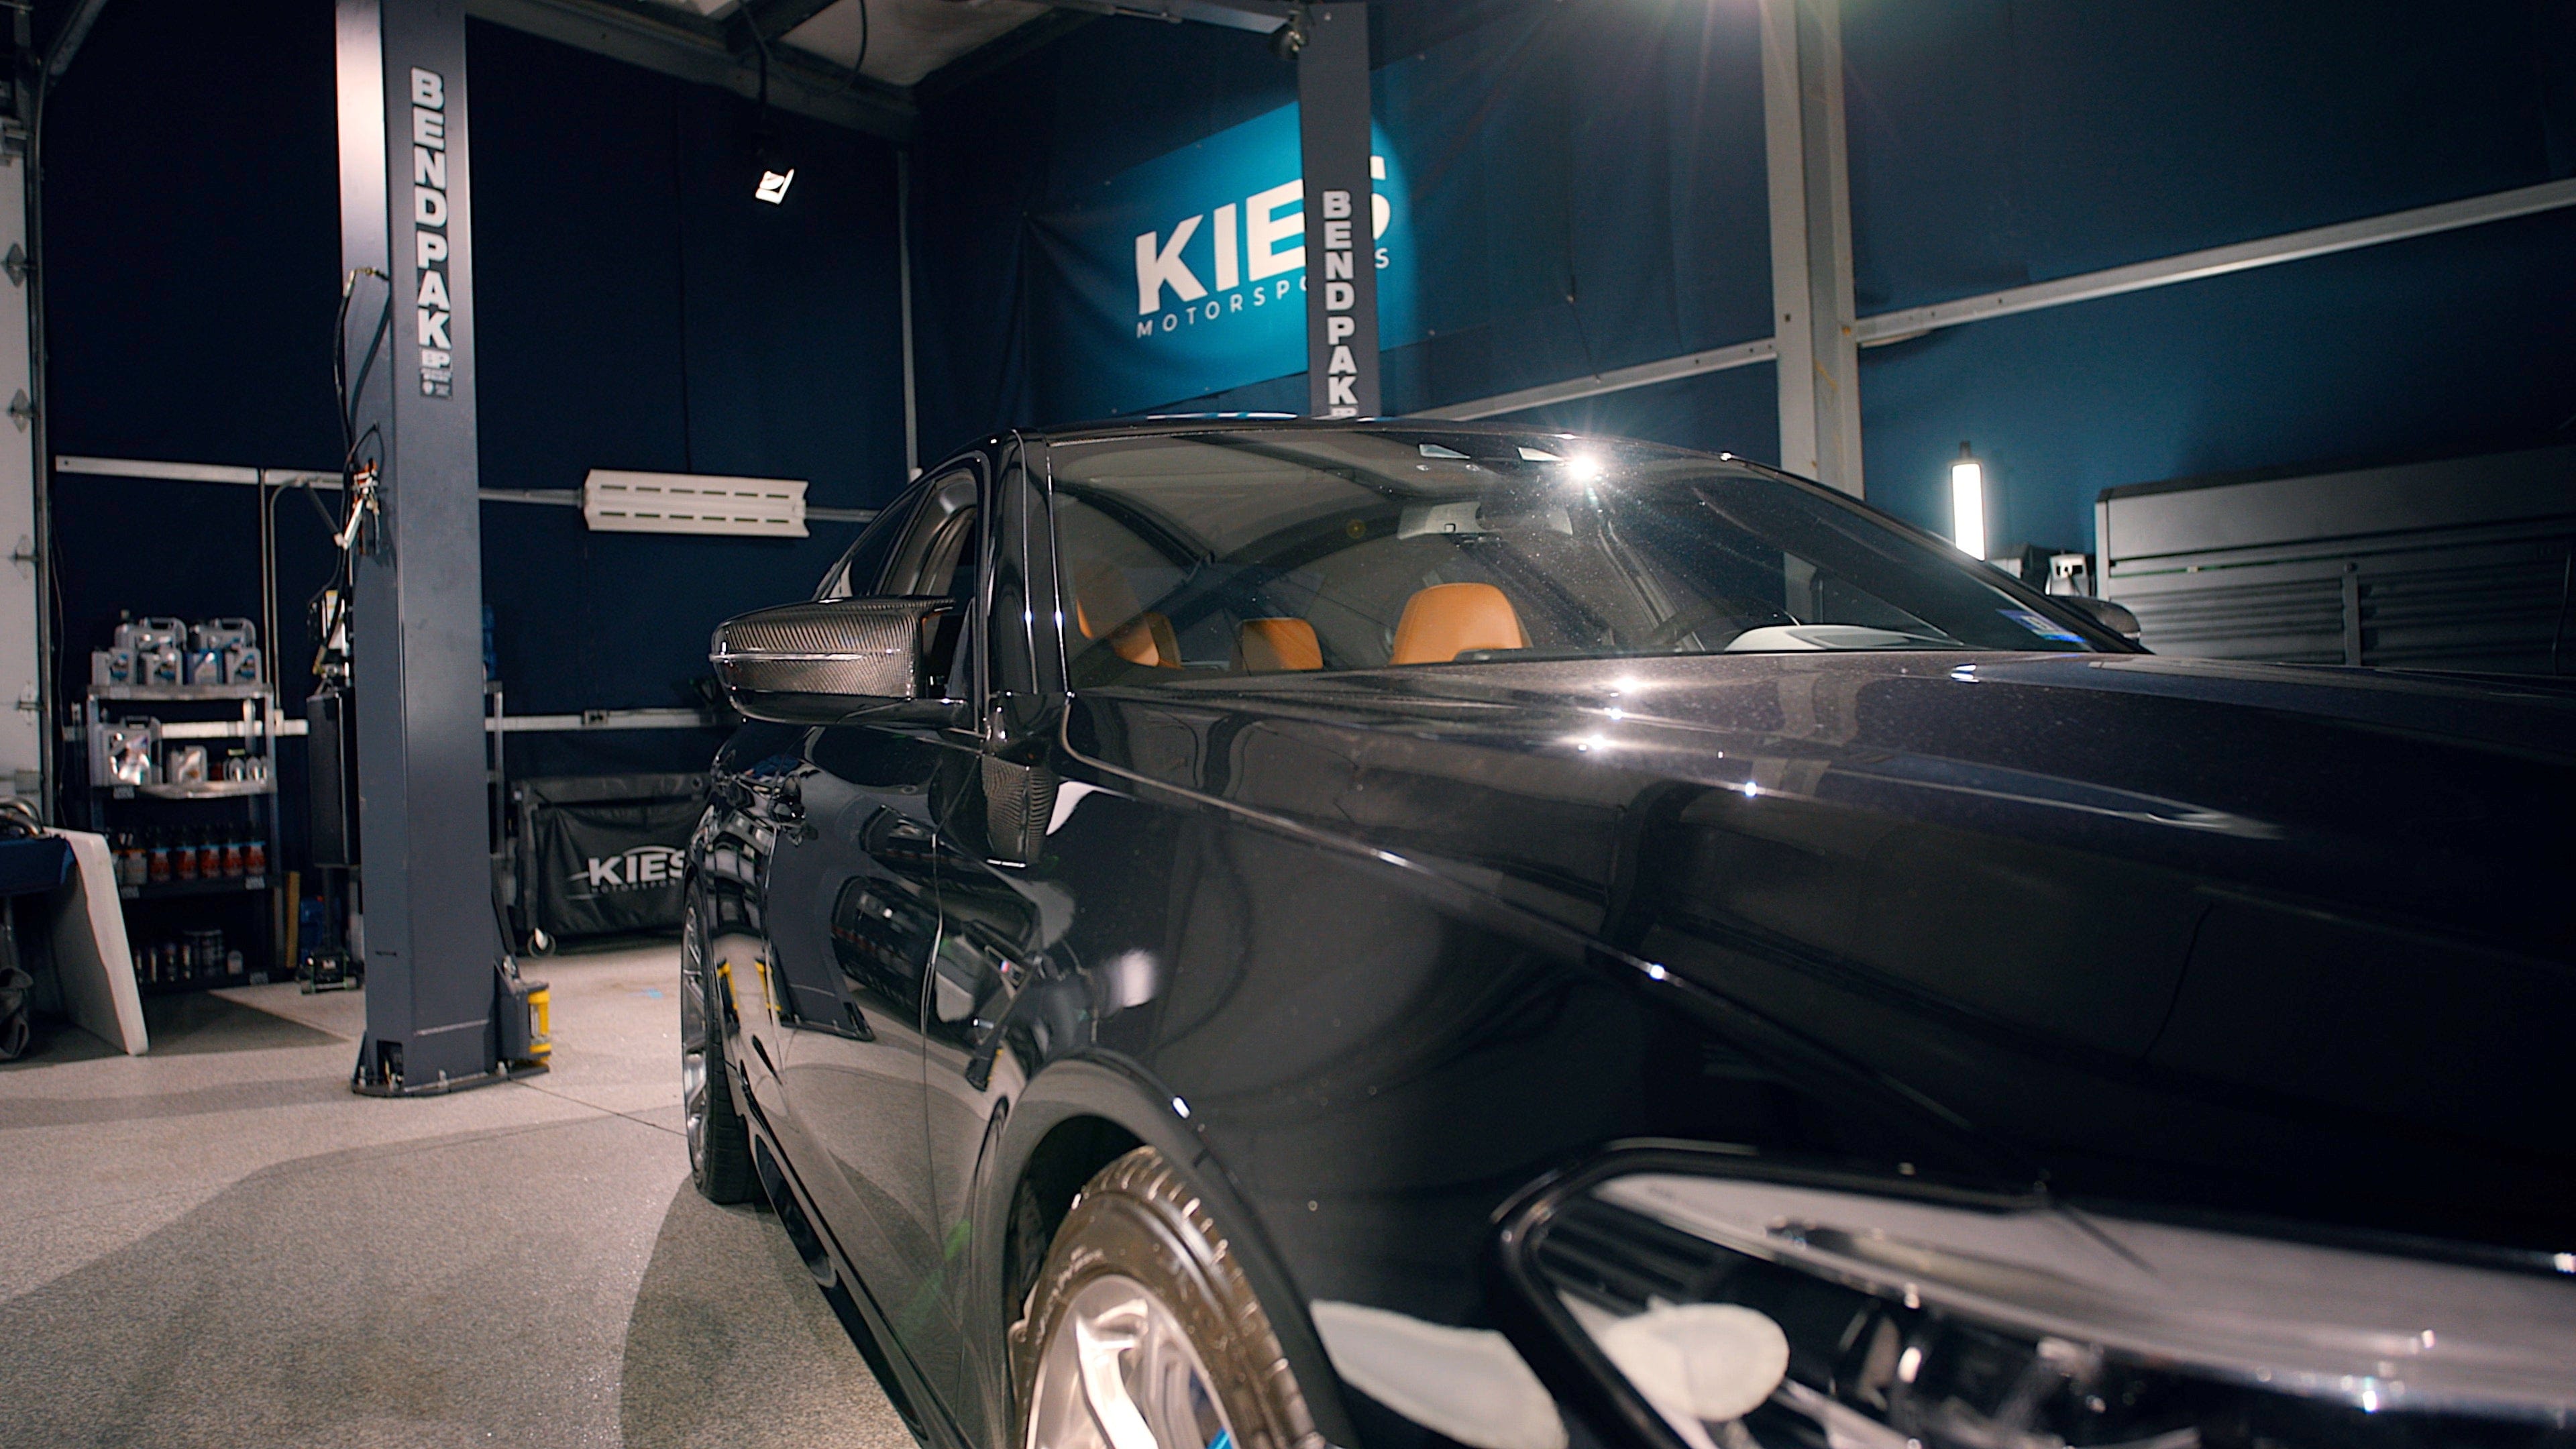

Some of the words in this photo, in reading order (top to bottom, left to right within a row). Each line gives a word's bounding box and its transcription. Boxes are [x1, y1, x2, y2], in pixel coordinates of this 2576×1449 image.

[411, 68, 452, 350] BENDPAK
[1136, 248, 1390, 338] MOTORSPS
[1322, 191, 1358, 405] BENDPAK
